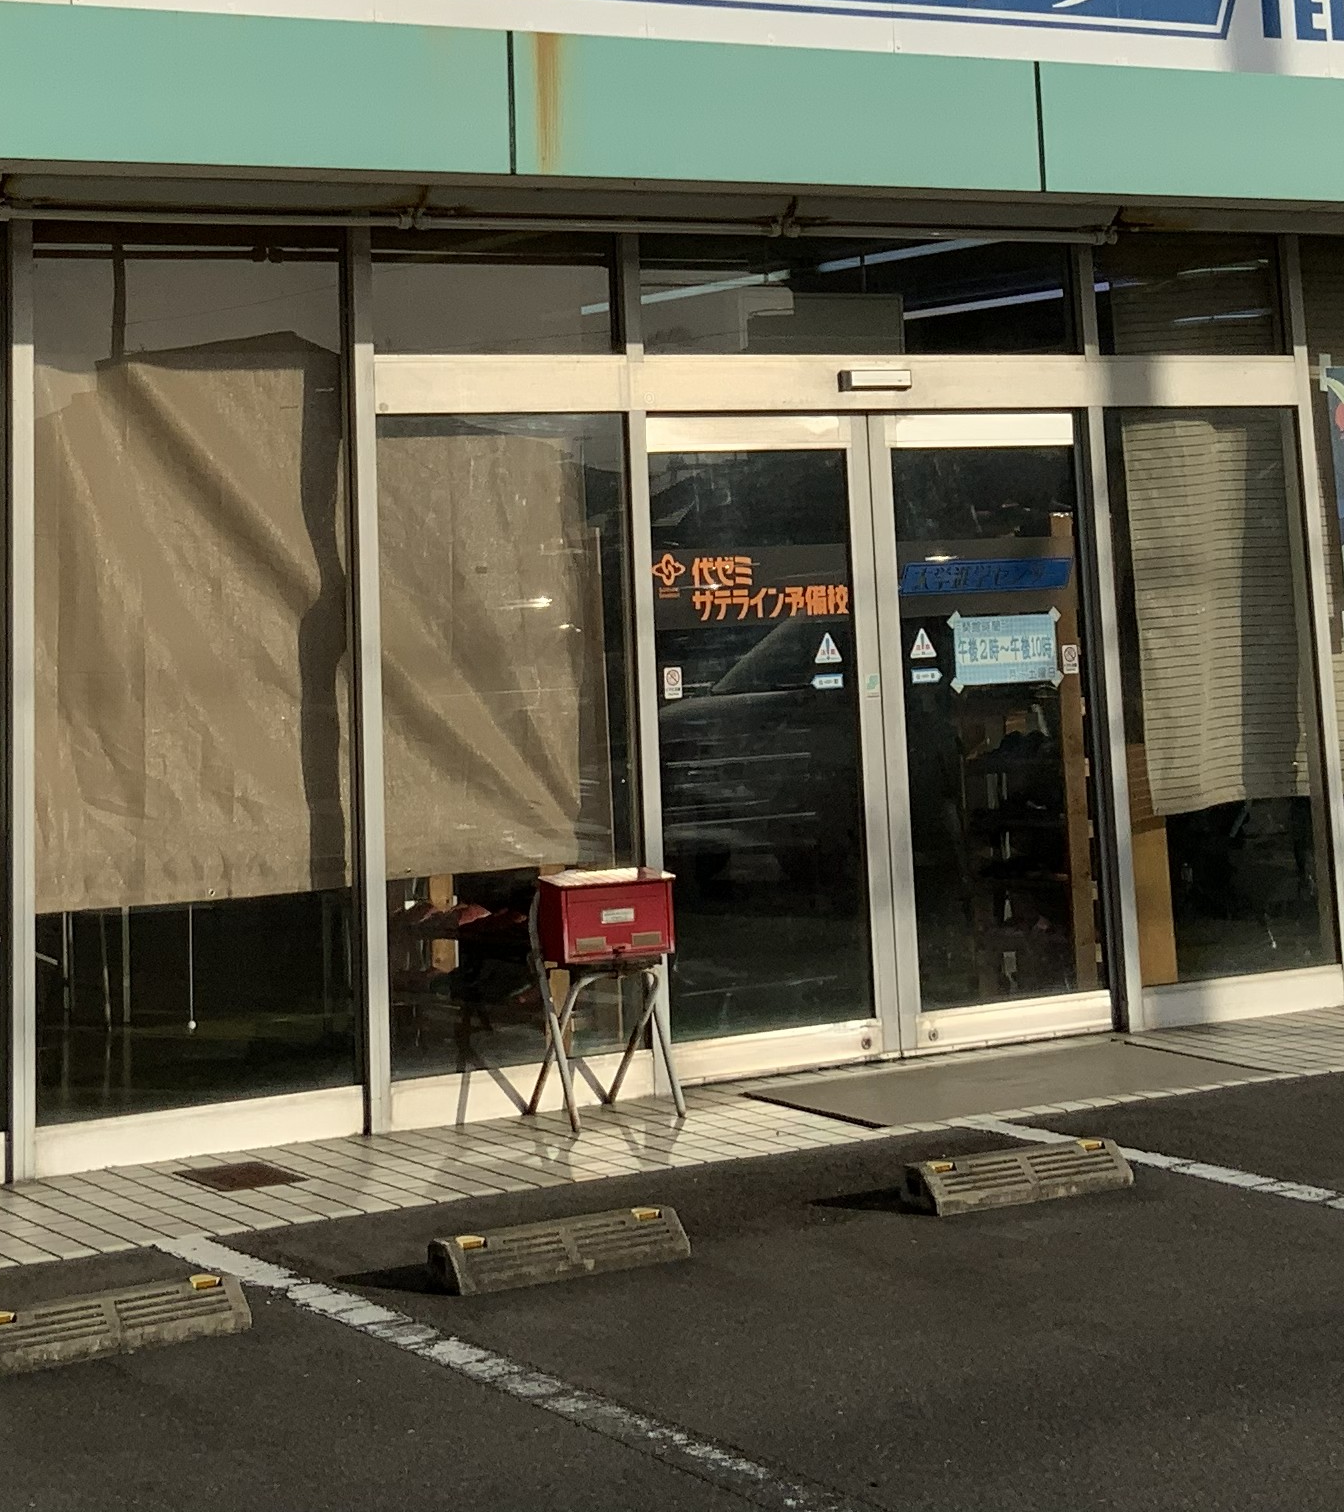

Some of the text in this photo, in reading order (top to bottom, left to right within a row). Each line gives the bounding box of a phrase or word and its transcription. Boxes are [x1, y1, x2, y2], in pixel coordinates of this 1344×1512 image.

[692, 556, 753, 587] 代ゼミ
[692, 584, 849, 621] サテライン予備校
